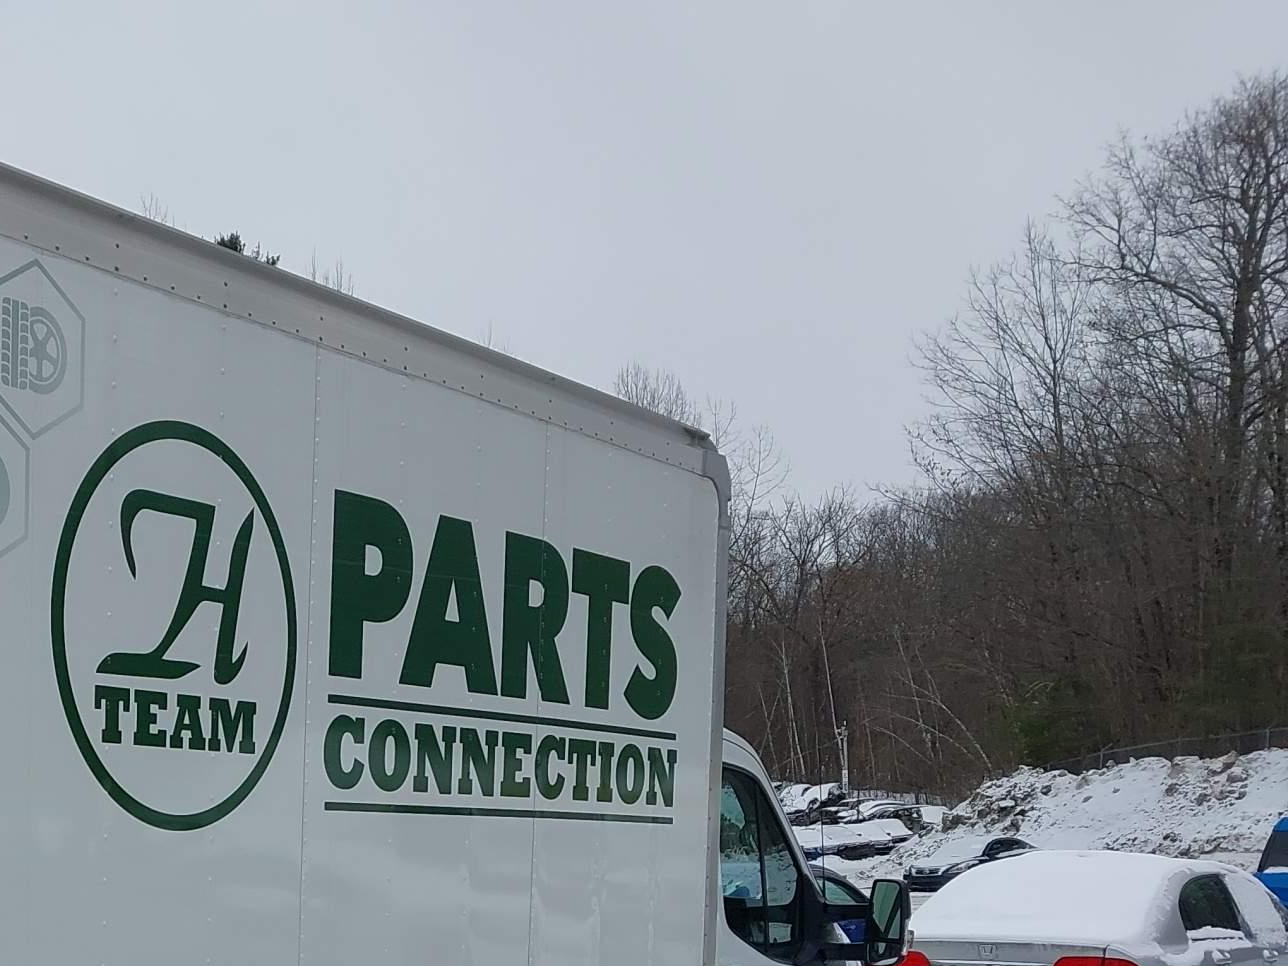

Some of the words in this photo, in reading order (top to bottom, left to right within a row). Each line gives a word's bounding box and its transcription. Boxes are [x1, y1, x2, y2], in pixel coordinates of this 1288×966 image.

[95, 488, 256, 686] H
[327, 489, 683, 720] PARTS
[94, 685, 258, 755] TEAM
[323, 713, 678, 808] CONNECTION
